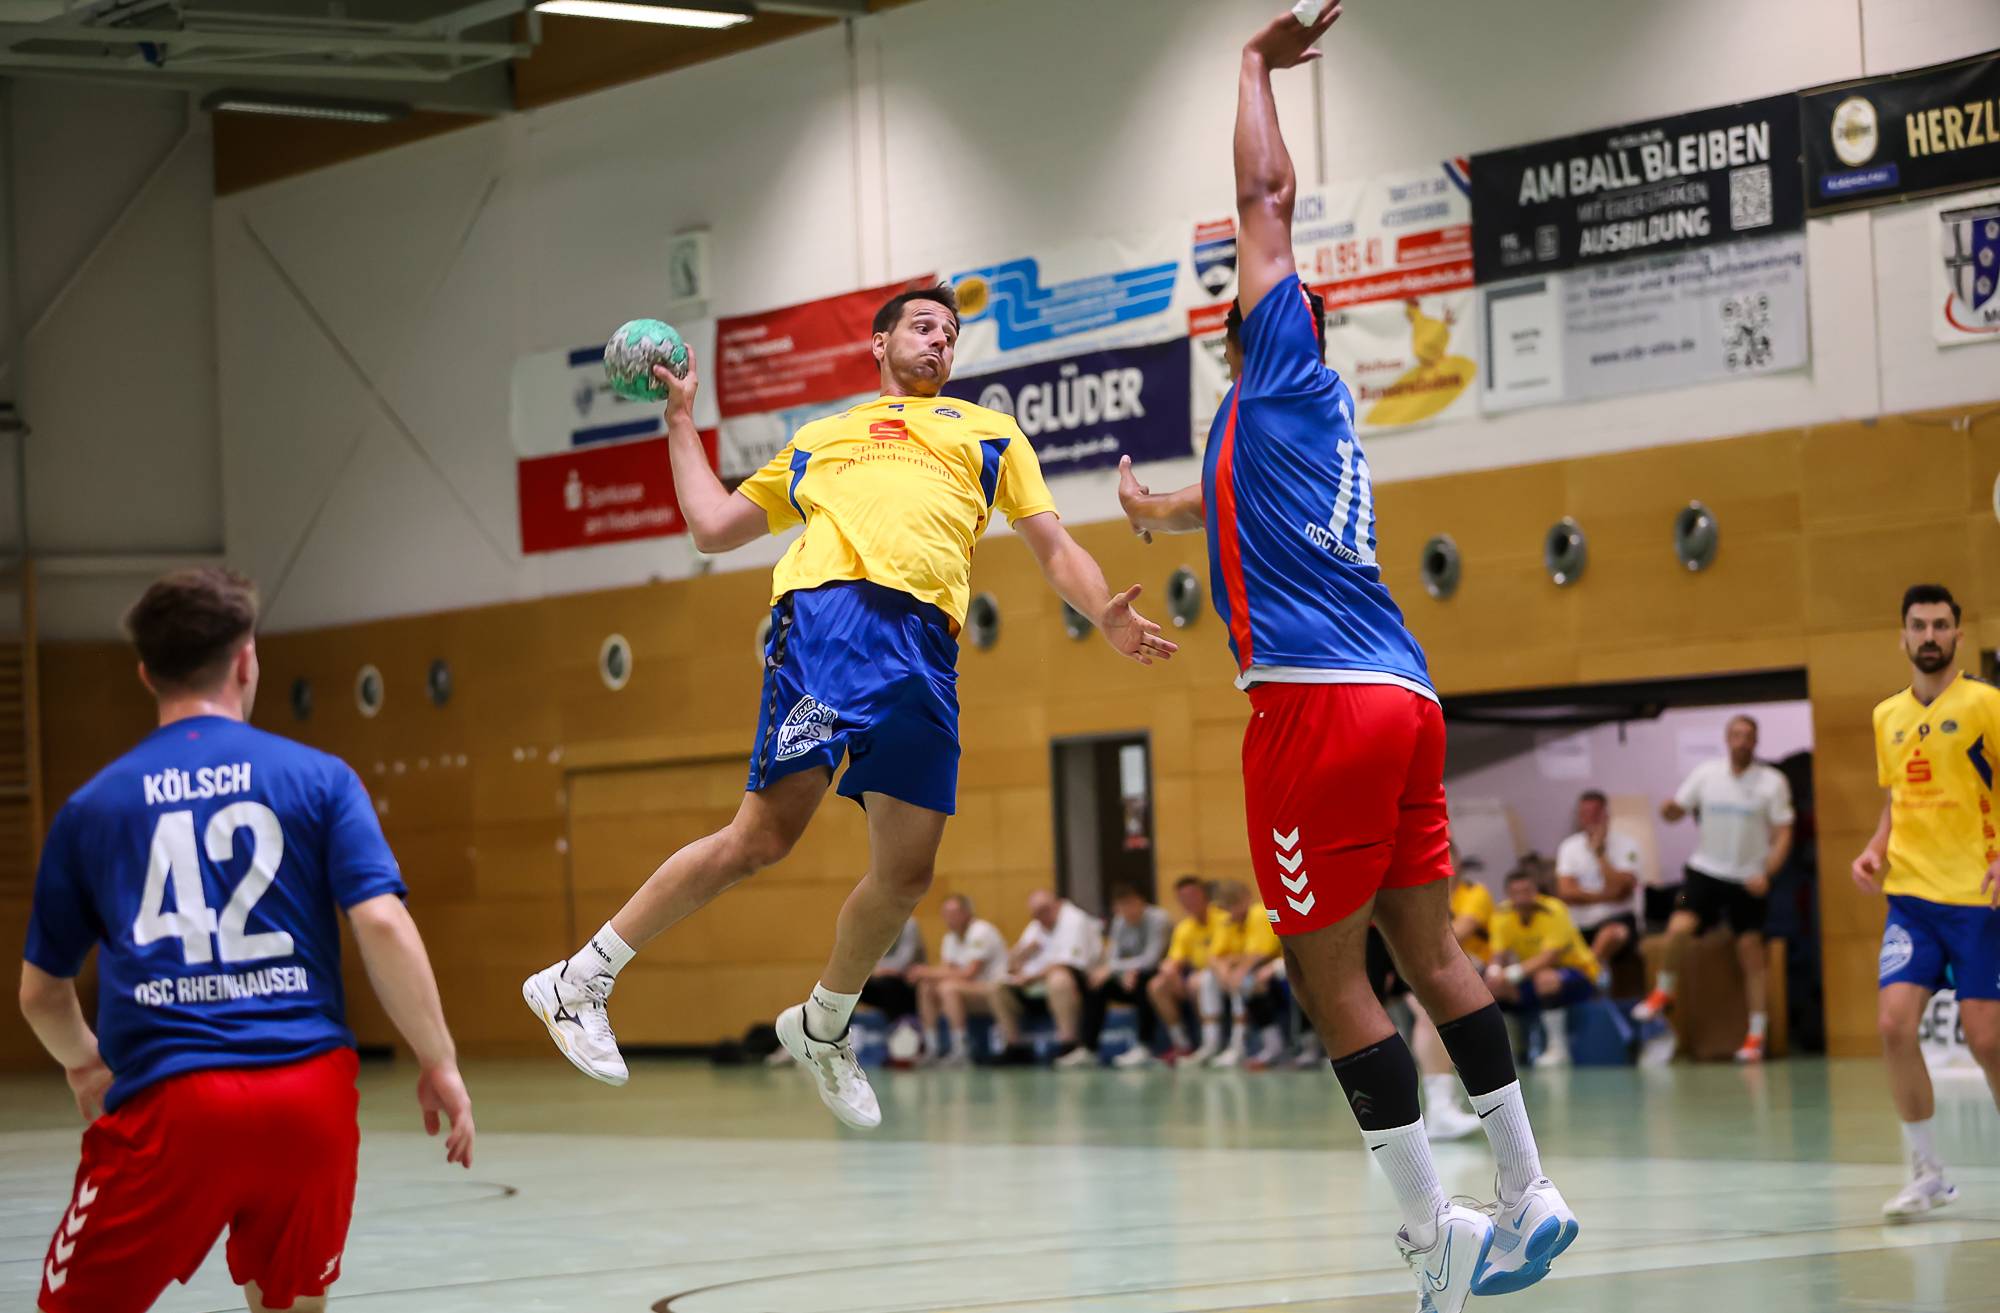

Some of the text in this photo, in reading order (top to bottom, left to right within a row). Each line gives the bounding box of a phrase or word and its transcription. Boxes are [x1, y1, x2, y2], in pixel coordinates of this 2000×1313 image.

[1906, 98, 2000, 157] HERZL
[1518, 162, 1567, 206] AM
[1569, 149, 1641, 196] BALL
[1640, 120, 1771, 182] BLEIBEN
[1578, 206, 1711, 257] AUSBILDUNG
[1016, 362, 1146, 436] GLÜDER
[860, 452, 951, 481] Niederrhein
[143, 761, 252, 806] KÖLSCH
[133, 801, 295, 965] 42
[134, 966, 309, 1006] OSC RHEINHAUSEN
